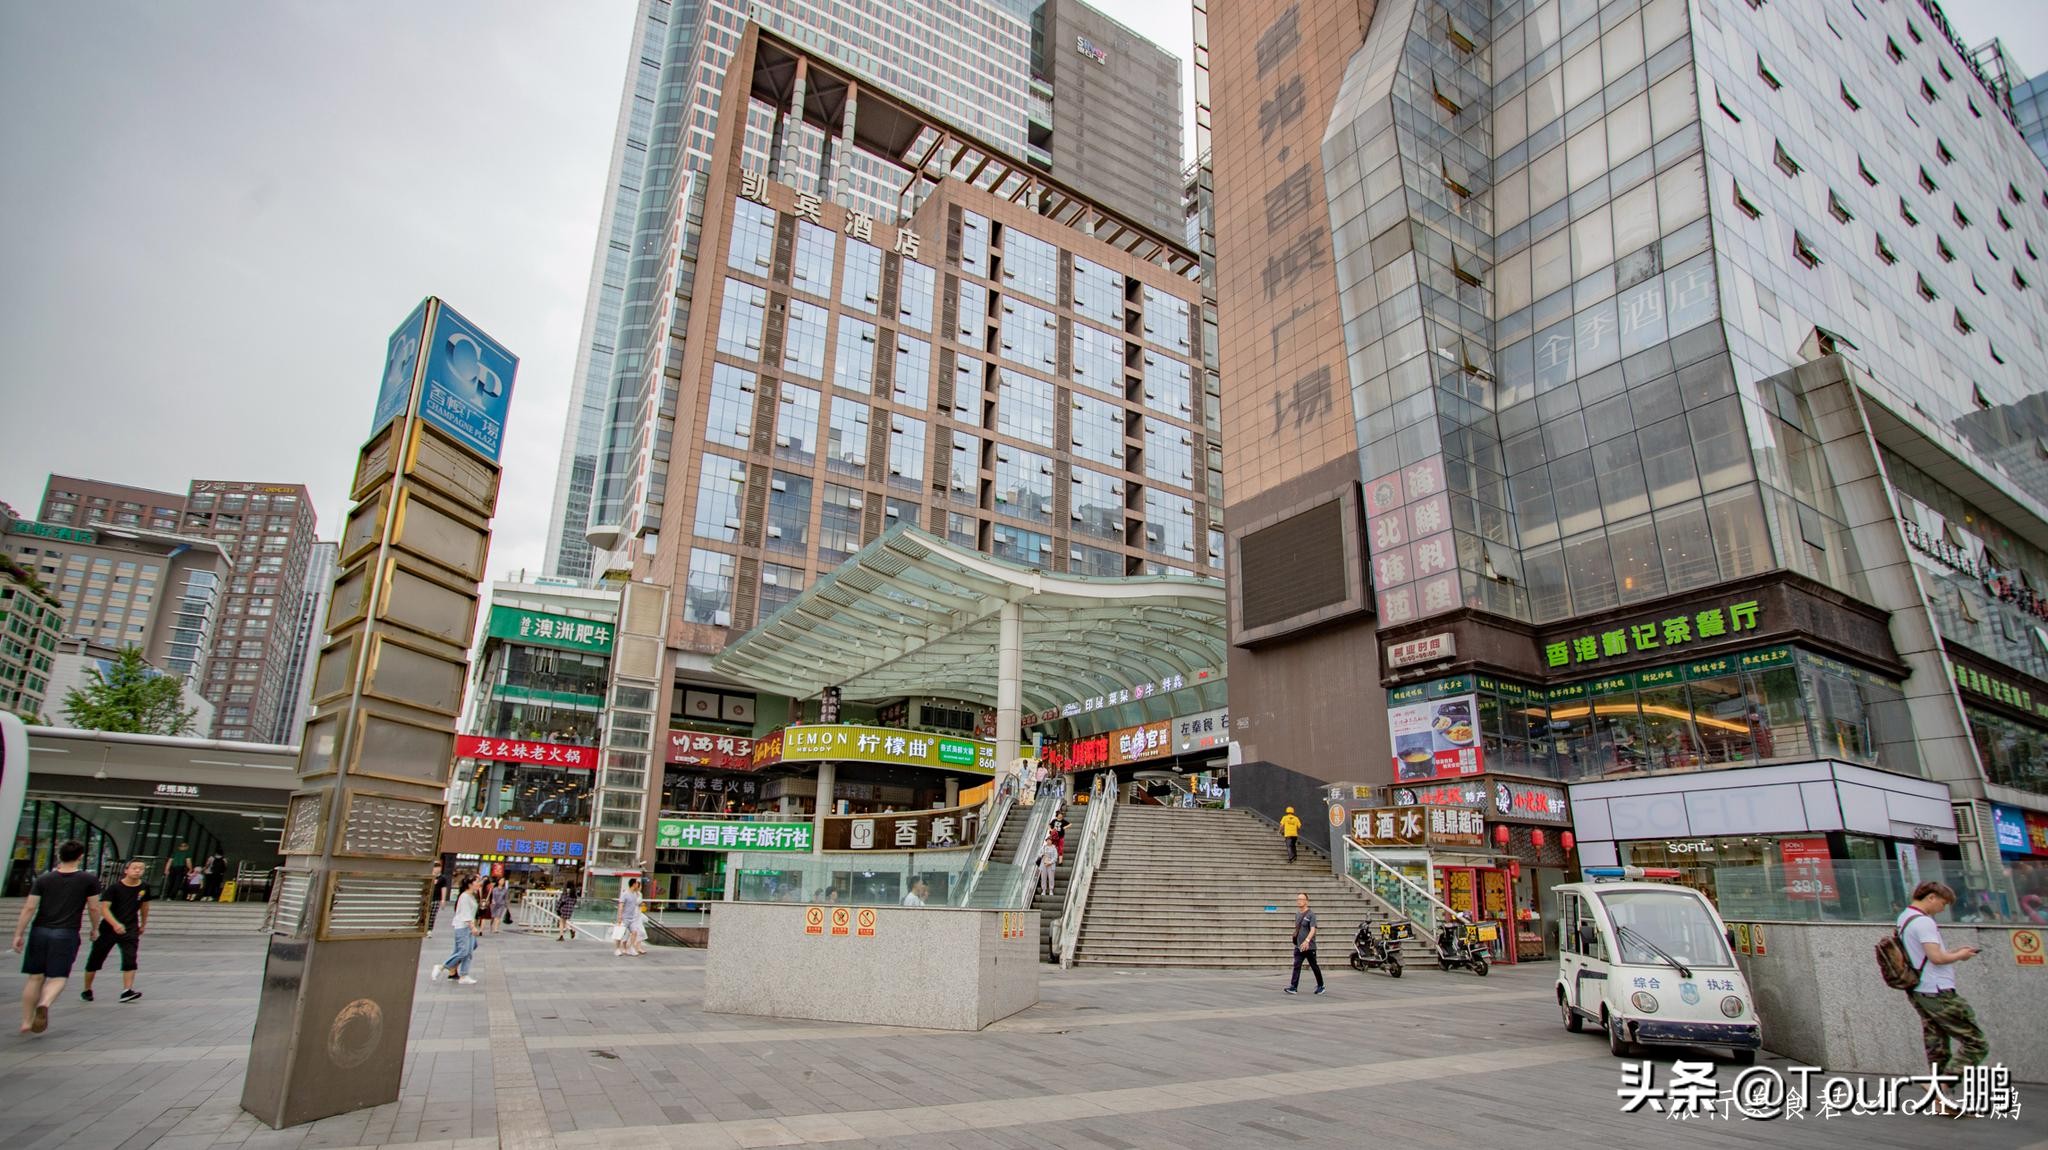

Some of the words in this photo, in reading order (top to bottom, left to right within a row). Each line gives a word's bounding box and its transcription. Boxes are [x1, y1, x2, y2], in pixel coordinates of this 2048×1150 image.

[741, 168, 920, 260] 凯宾酒店
[1537, 267, 1711, 371] 全季酒店
[426, 400, 474, 434] CHAMPAGNE
[474, 426, 497, 449] PLAZA
[533, 617, 610, 646] 澳洲肥牛
[1545, 600, 1759, 668] 香港新记茶餐厅
[787, 732, 848, 746] LEMON
[857, 733, 928, 759] 柠檬曲
[449, 814, 504, 830] CRAZY
[1353, 810, 1424, 840] 烟酒水
[681, 824, 810, 849] 中国青年旅行社
[1668, 842, 1706, 854] SOFIT
[1632, 976, 1661, 990] 综合
[1706, 978, 1735, 992] 执法
